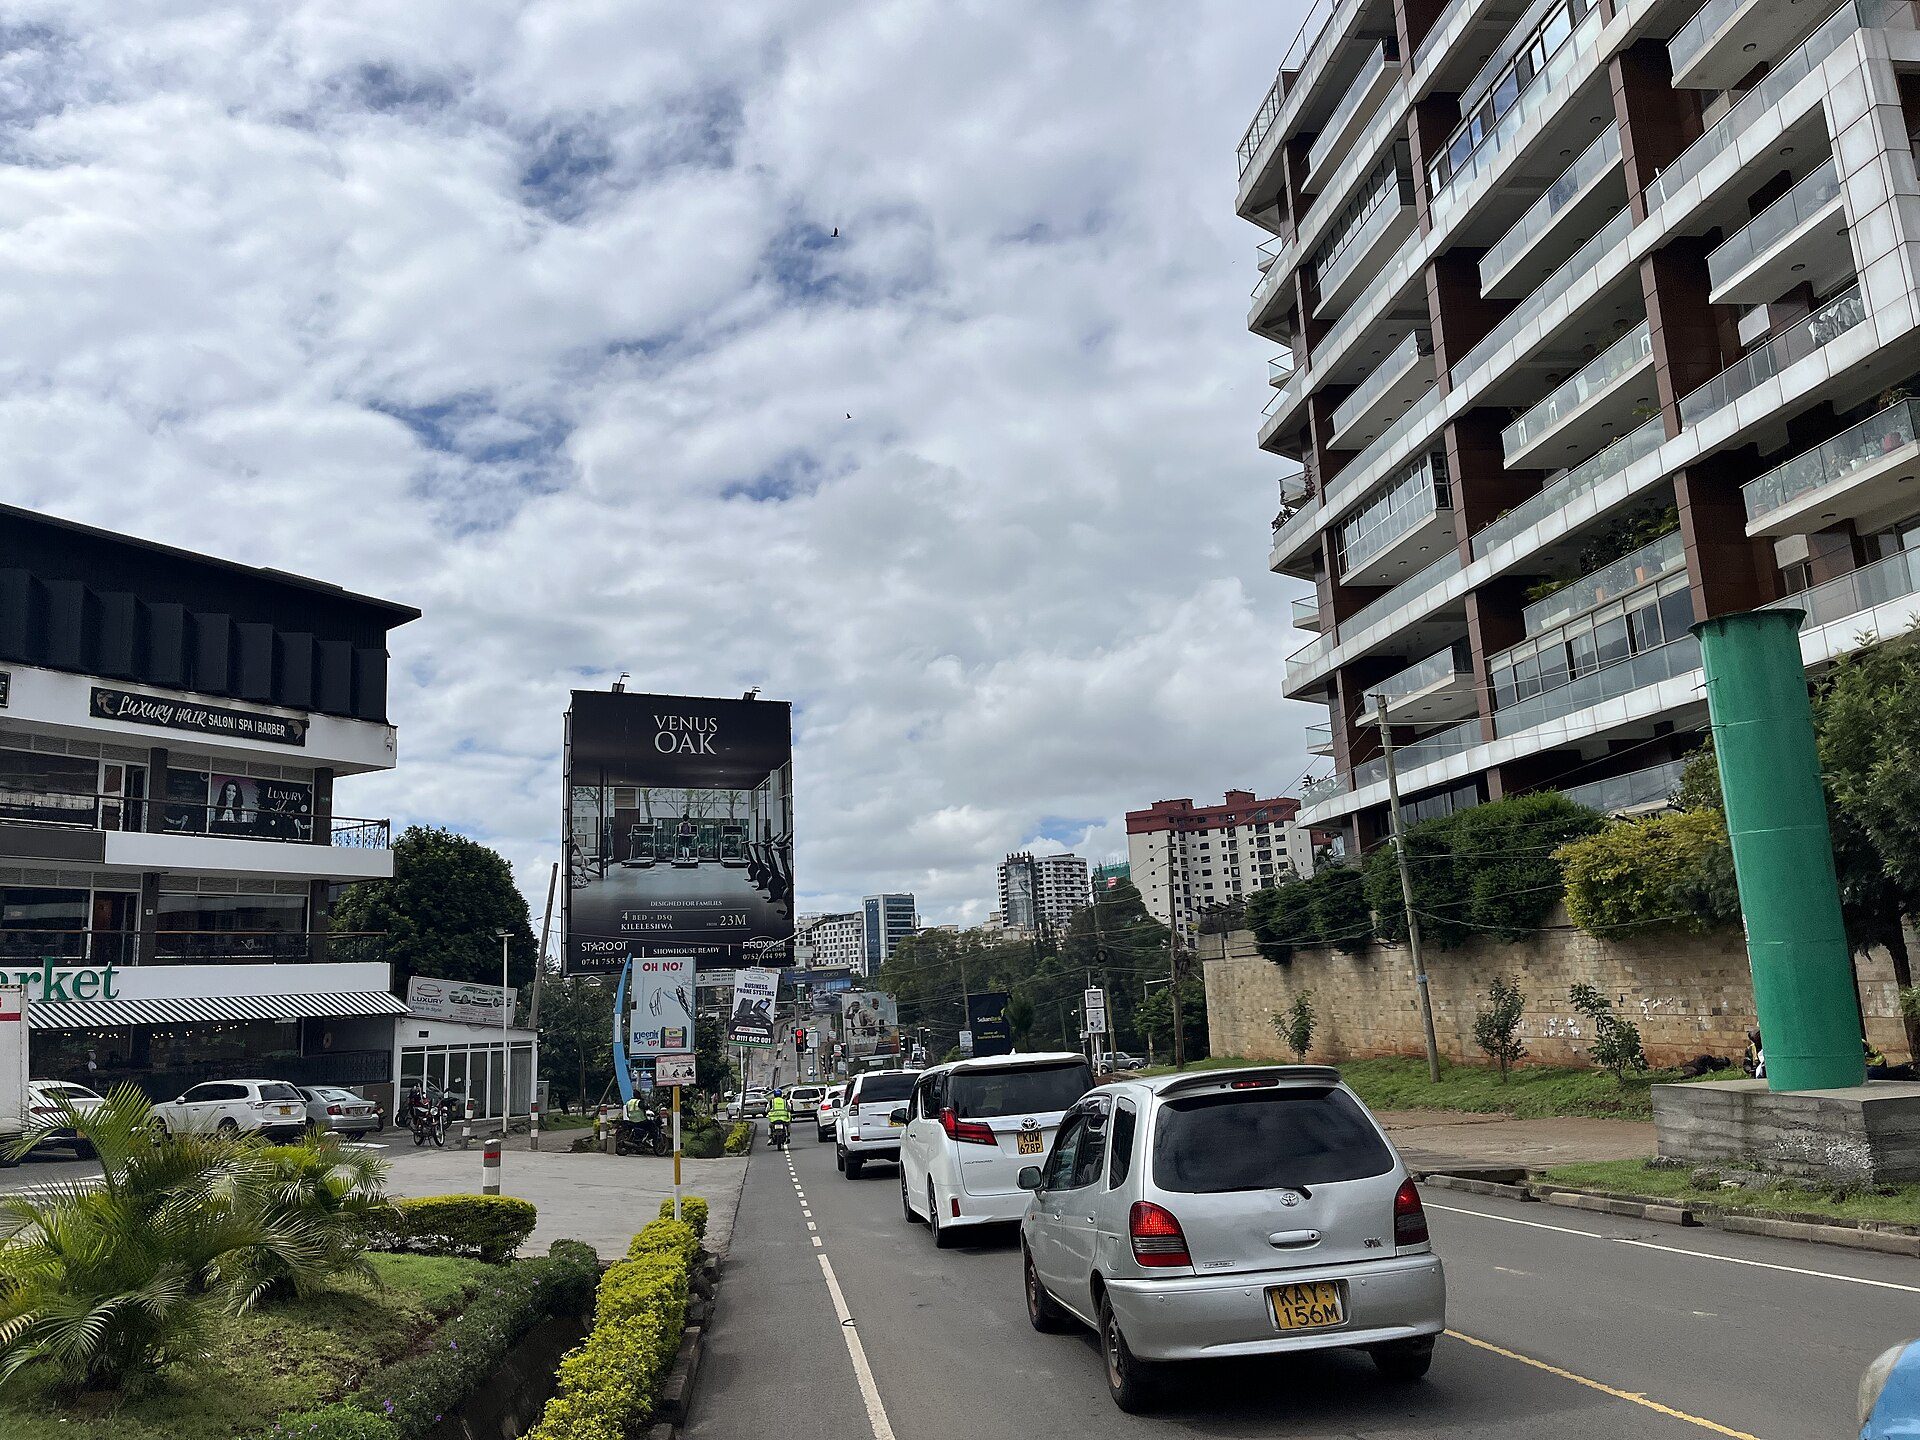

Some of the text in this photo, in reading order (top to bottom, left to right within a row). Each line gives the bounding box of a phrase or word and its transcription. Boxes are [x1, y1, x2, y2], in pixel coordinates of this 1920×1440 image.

[208, 714, 234, 727] SALON
[238, 719, 253, 732] SPA
[257, 721, 286, 737] BARBER
[653, 714, 718, 733] VENUS
[654, 731, 717, 755] OAK
[267, 786, 305, 803] LUXURY
[621, 911, 628, 921] 4
[719, 914, 747, 926] 23M
[581, 941, 628, 952] STAROOT
[653, 946, 720, 955] SHOWHOUSE READY
[581, 956, 627, 966] 0741 755 55
[642, 962, 684, 972] OH NO!
[0, 955, 120, 1002] rket
[744, 982, 768, 990] BUSINESS
[752, 989, 775, 997] SYSTEMS
[411, 996, 444, 1005] LUXURY
[1020, 1143, 1041, 1154] 678P
[1279, 1282, 1319, 1307] KAY
[1283, 1303, 1340, 1328] 156M
